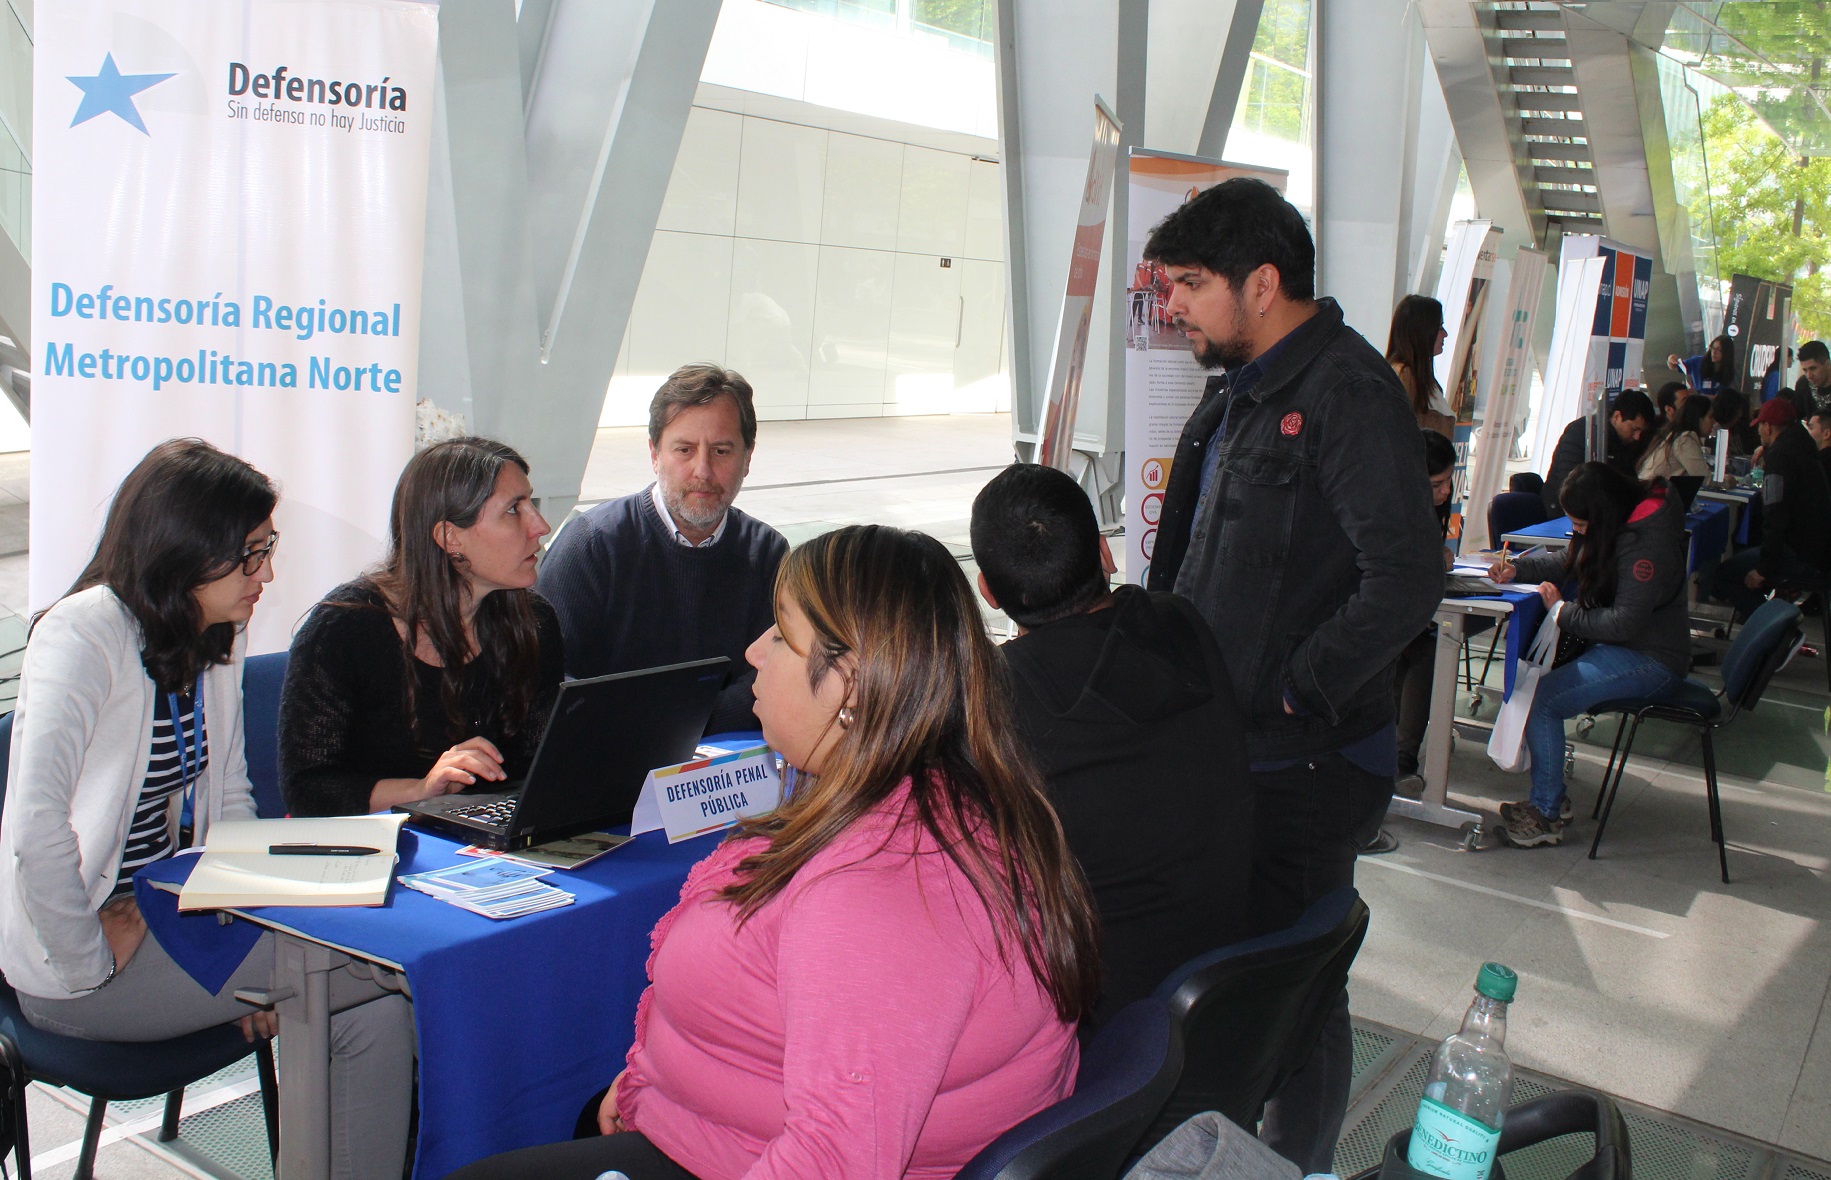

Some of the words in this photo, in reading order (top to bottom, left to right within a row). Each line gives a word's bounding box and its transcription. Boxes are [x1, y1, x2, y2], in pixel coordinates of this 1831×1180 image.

[228, 62, 407, 112] Defensoría
[227, 100, 248, 120] Sin
[253, 102, 305, 125] defensa
[310, 112, 326, 127] no
[331, 109, 355, 133] hay
[358, 113, 405, 134] Justicia
[1634, 279, 1649, 300] UNAP
[50, 282, 241, 328] Defensoría
[252, 295, 401, 341] Regional
[44, 342, 298, 391] Metropolitana
[308, 356, 402, 393] Norte
[666, 769, 733, 803] DEFENSORÍA
[735, 764, 768, 786] PENAL
[700, 791, 749, 817] PÚBLICA
[1439, 1112, 1463, 1127] NATURAL
